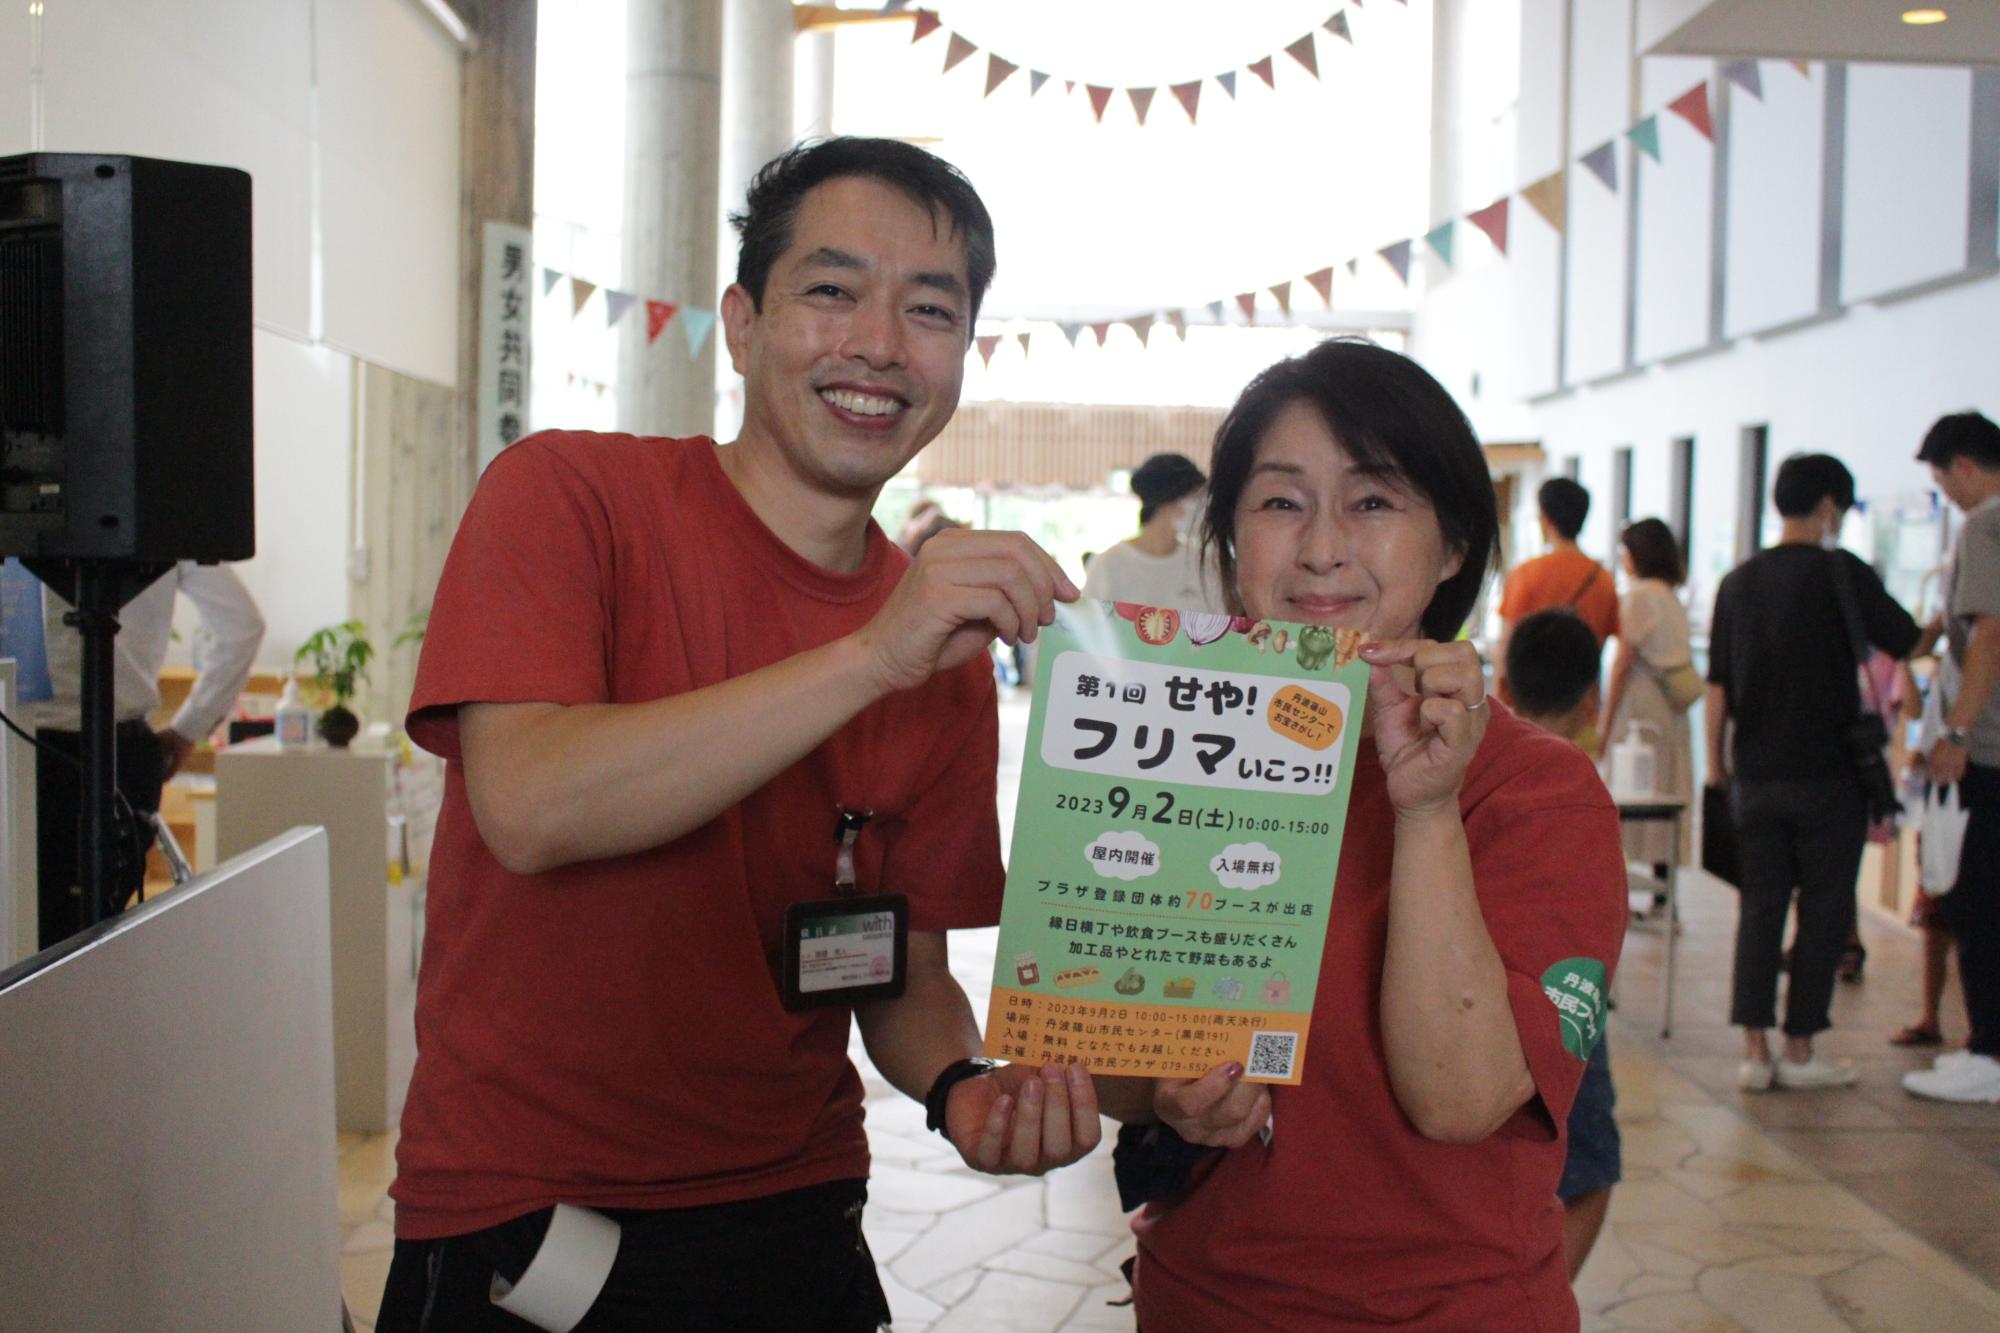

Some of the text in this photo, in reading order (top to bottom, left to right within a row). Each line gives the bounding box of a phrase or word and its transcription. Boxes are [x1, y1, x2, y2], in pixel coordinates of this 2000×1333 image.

[1076, 674, 1257, 715] 第1回 せや!
[1274, 698, 1335, 733] 市民センターで
[1092, 846, 1155, 865] 屋内開催
[1216, 859, 1275, 875] 入場無料
[1069, 941, 1272, 968] 加工品やとれたて野菜もあるよ
